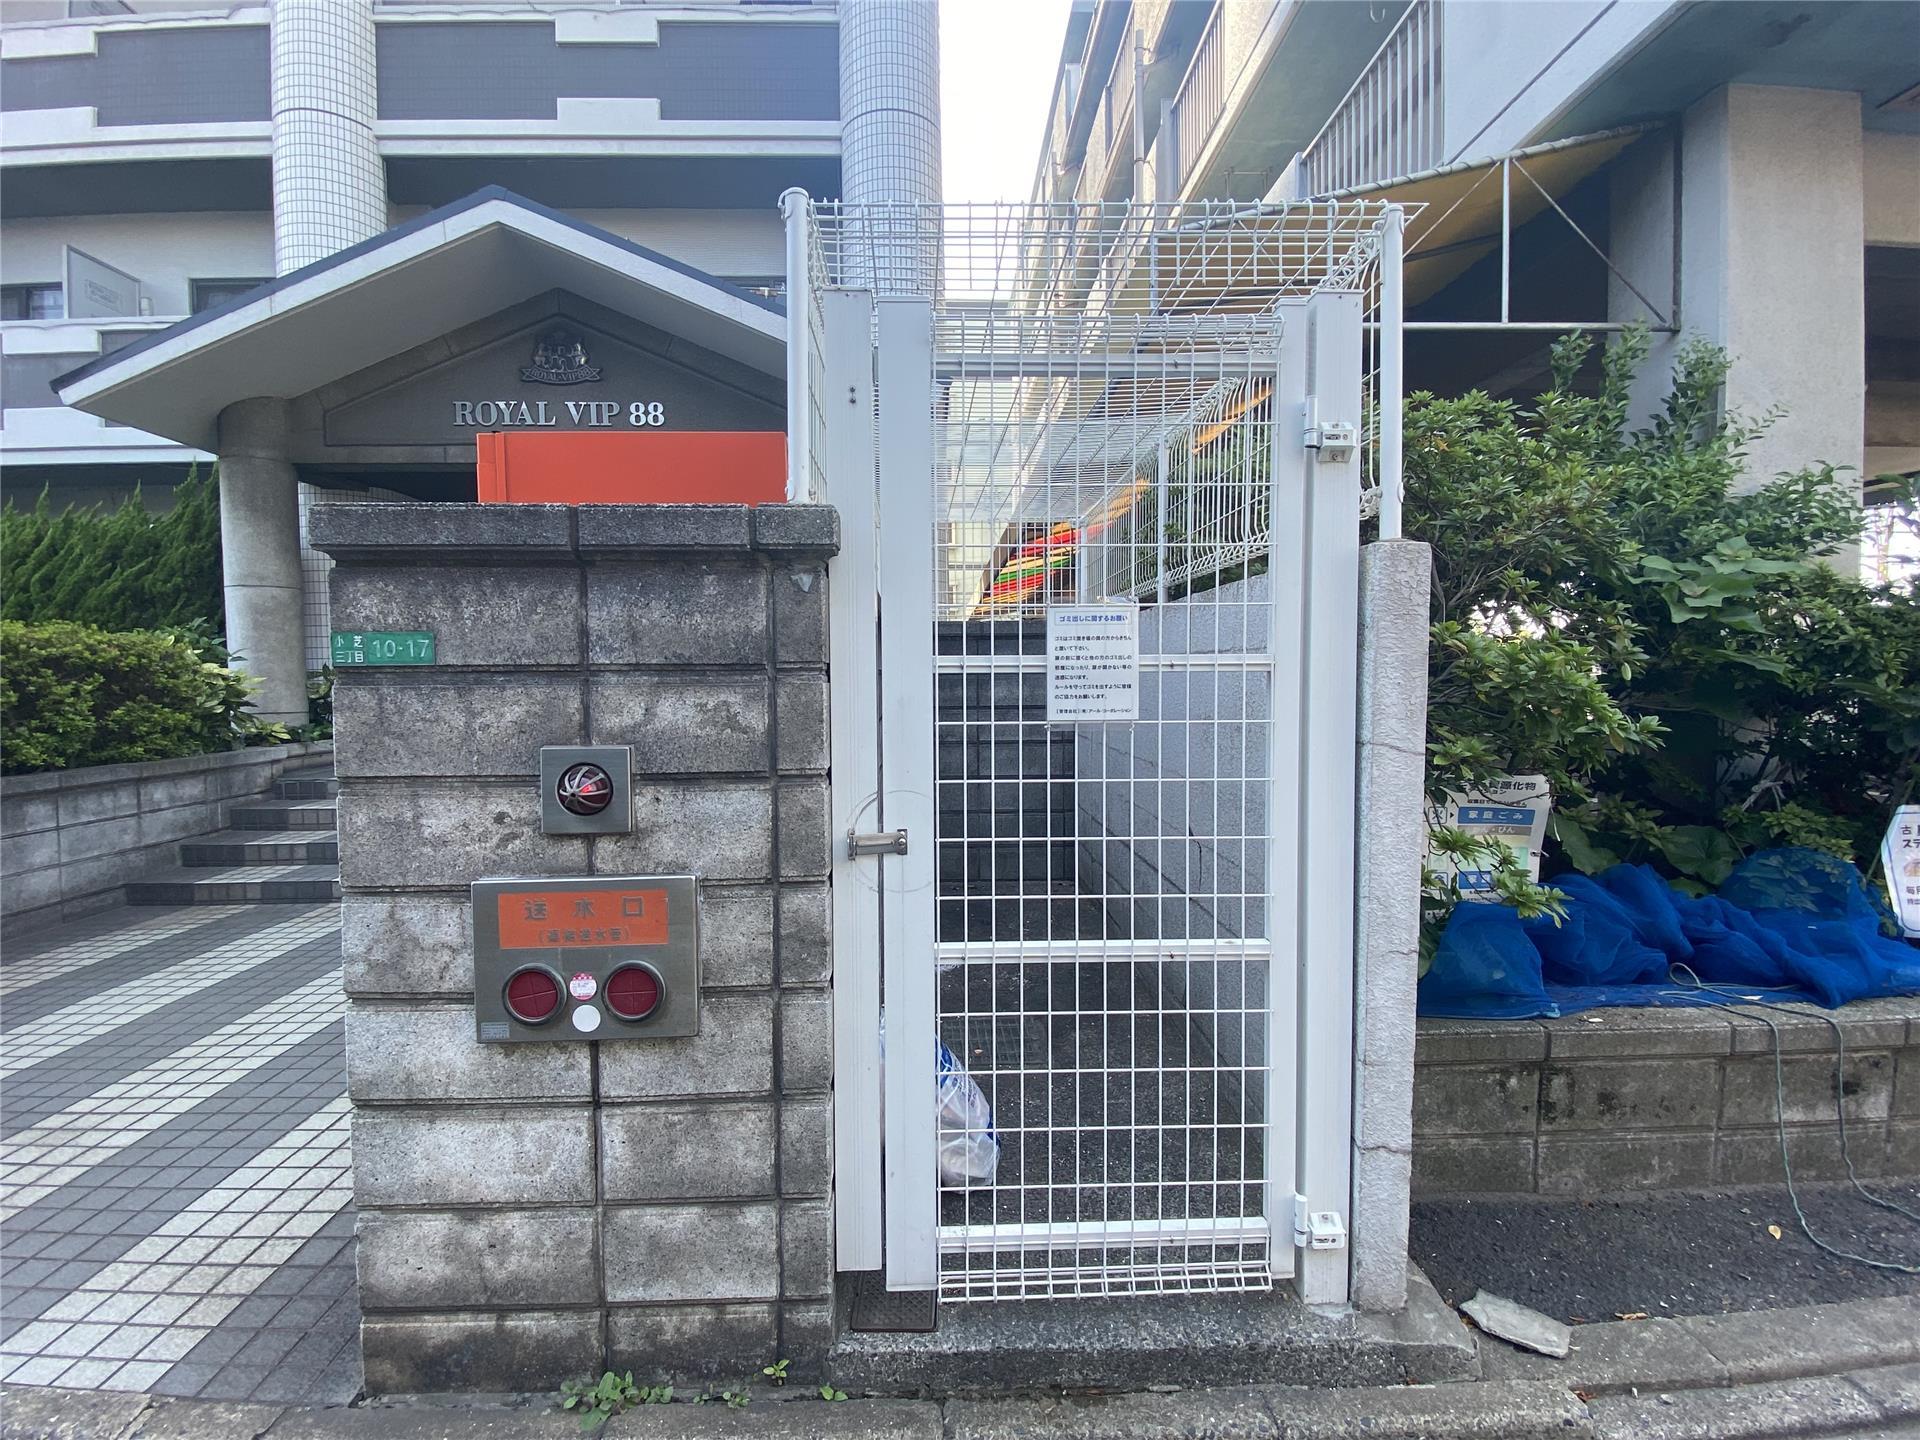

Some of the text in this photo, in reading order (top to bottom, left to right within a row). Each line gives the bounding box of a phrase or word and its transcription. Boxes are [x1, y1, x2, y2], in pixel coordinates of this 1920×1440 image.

[453, 401, 665, 426] ROYAL VIP 88
[335, 634, 363, 648] 小芝
[372, 639, 430, 658] 10-17
[335, 650, 364, 663] 三丁目
[1467, 809, 1524, 821] 家庭ごみ
[524, 895, 644, 921] 送水口
